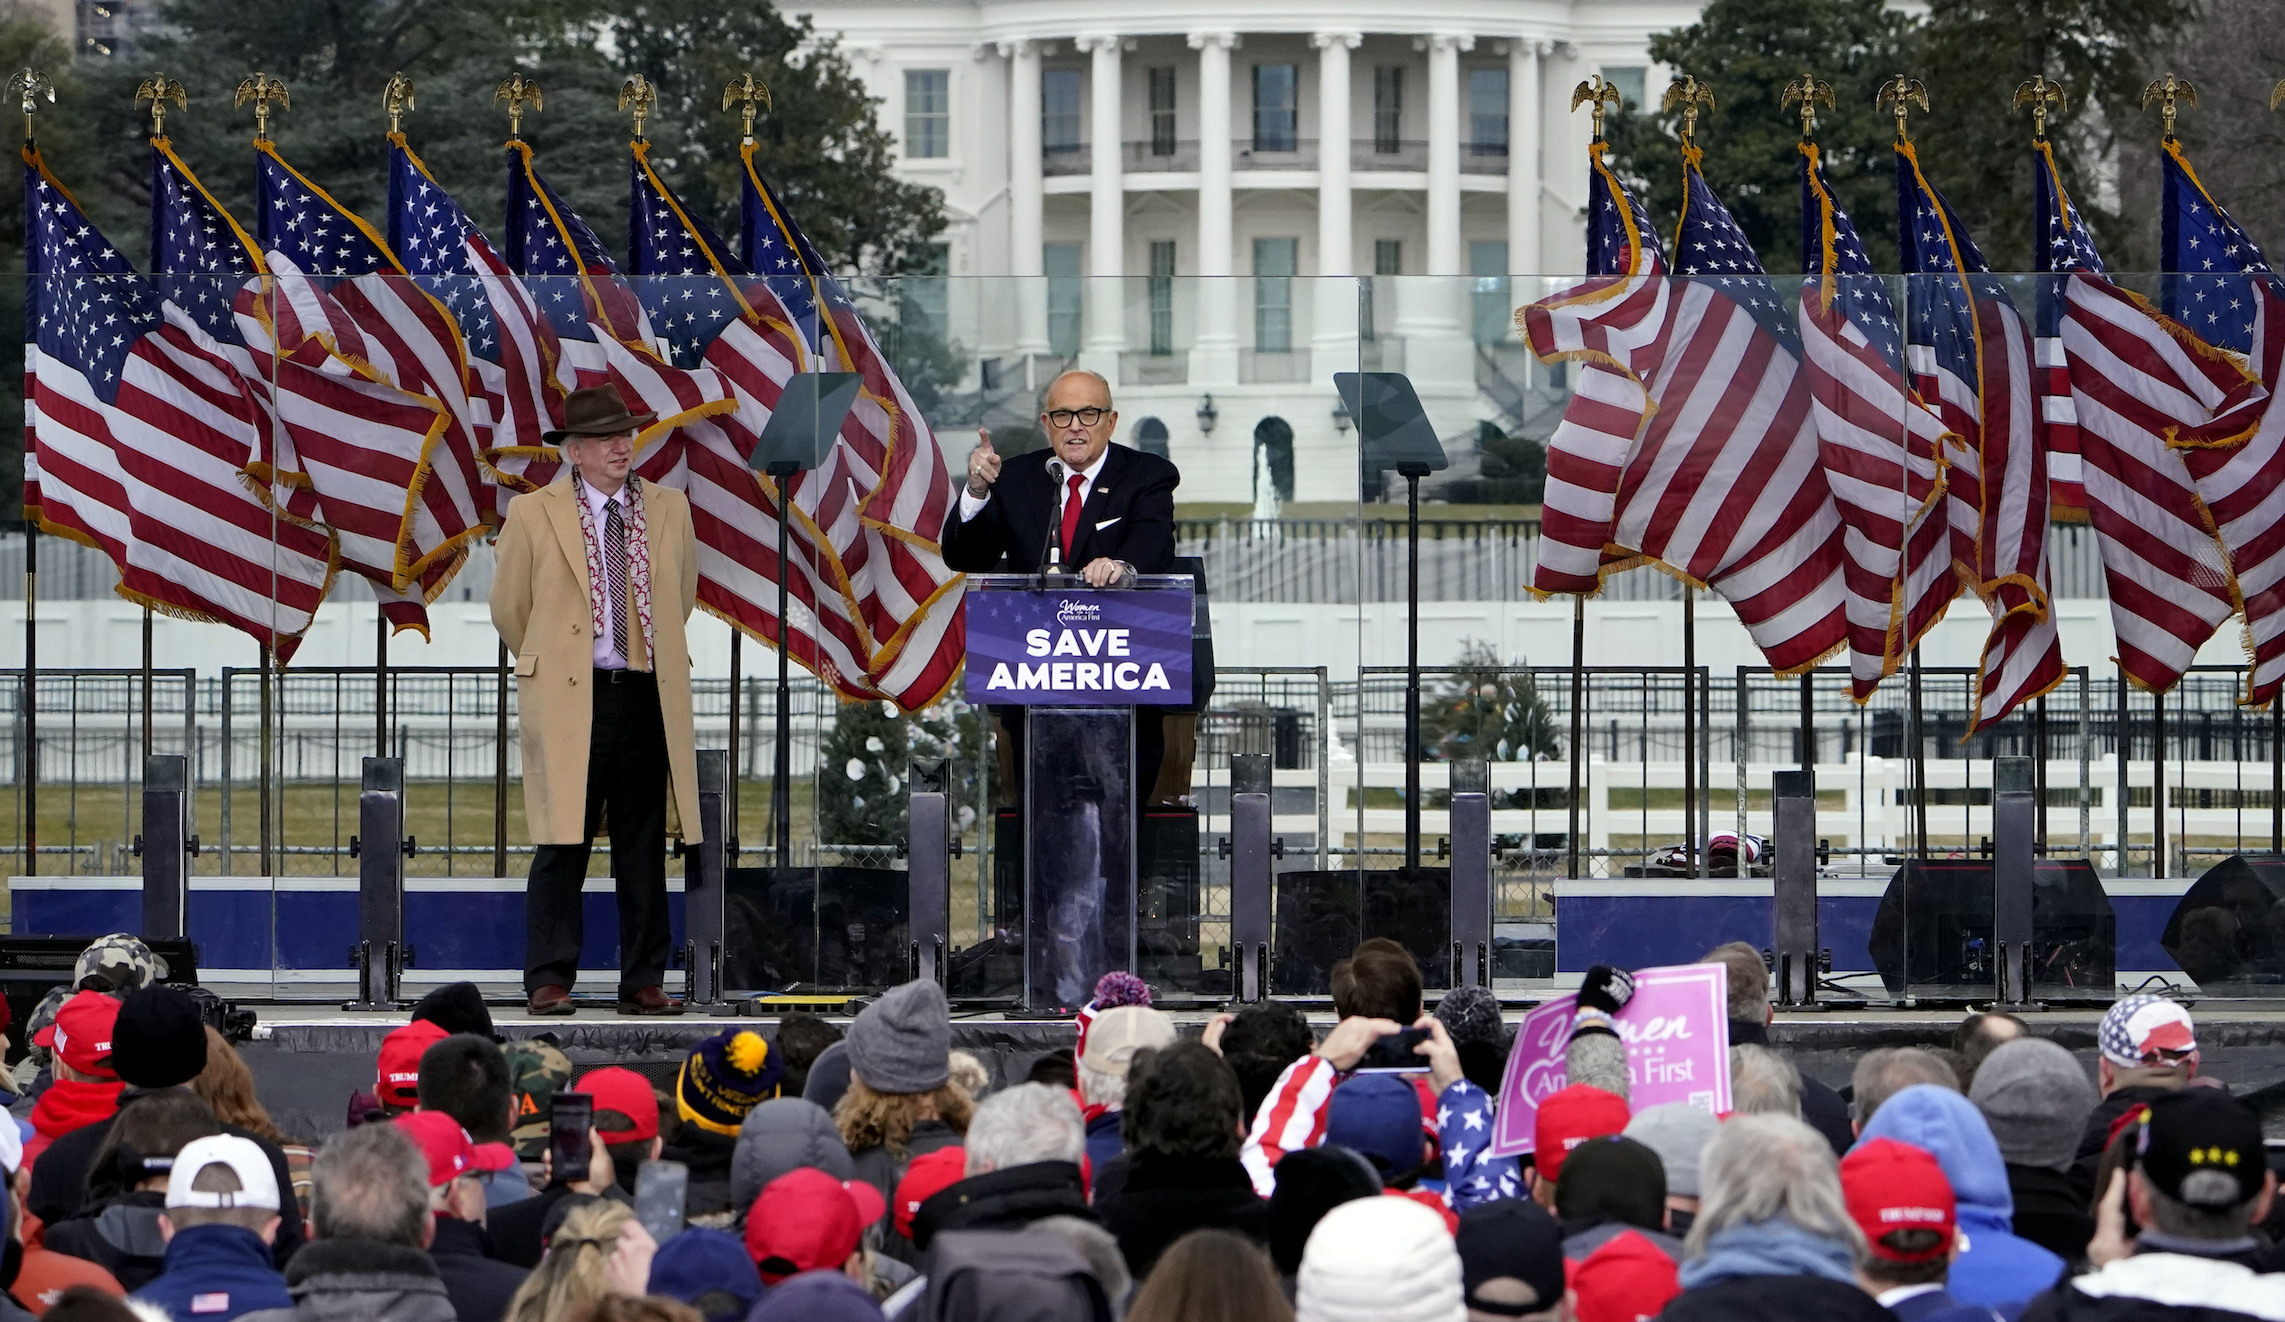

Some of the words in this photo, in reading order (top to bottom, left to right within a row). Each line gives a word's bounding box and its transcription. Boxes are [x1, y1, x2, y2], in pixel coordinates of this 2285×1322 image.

[1060, 599, 1100, 612] Women
[1026, 629, 1130, 657] SAVE
[986, 662, 1171, 690] AMERICA
[1644, 1057, 1694, 1085] First
